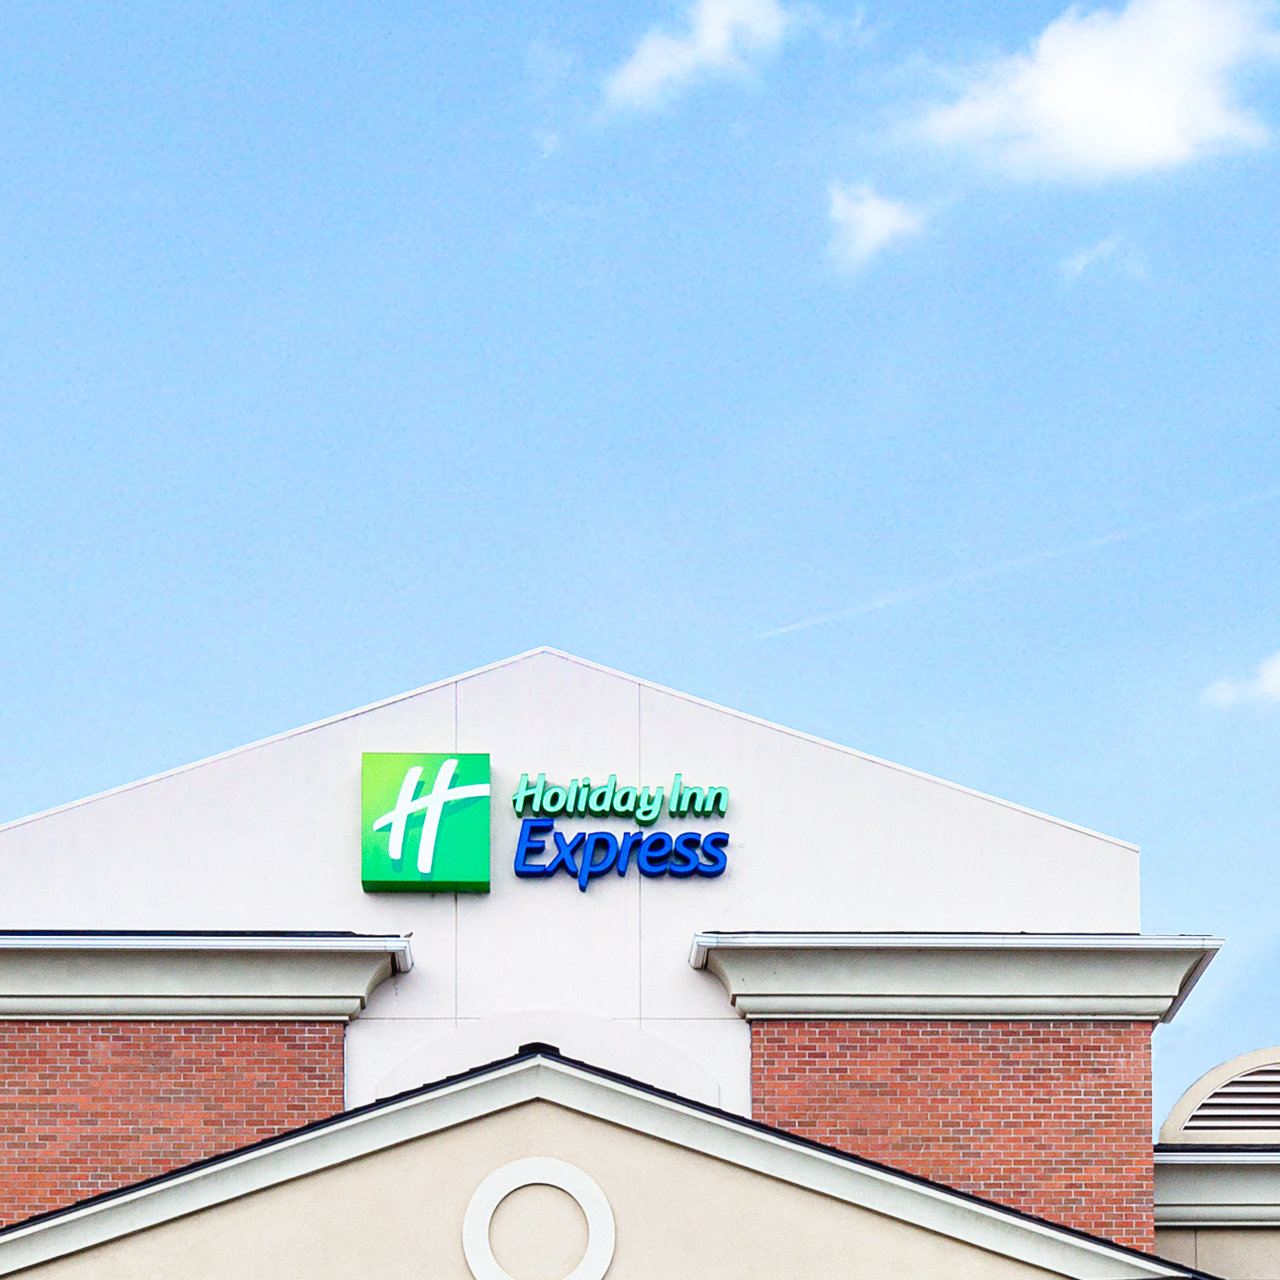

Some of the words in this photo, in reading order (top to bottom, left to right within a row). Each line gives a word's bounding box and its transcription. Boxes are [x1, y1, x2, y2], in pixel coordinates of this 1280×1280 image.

[373, 759, 490, 874] H
[512, 773, 663, 826] Holiday
[668, 773, 730, 818] Inn
[513, 818, 730, 892] Express
